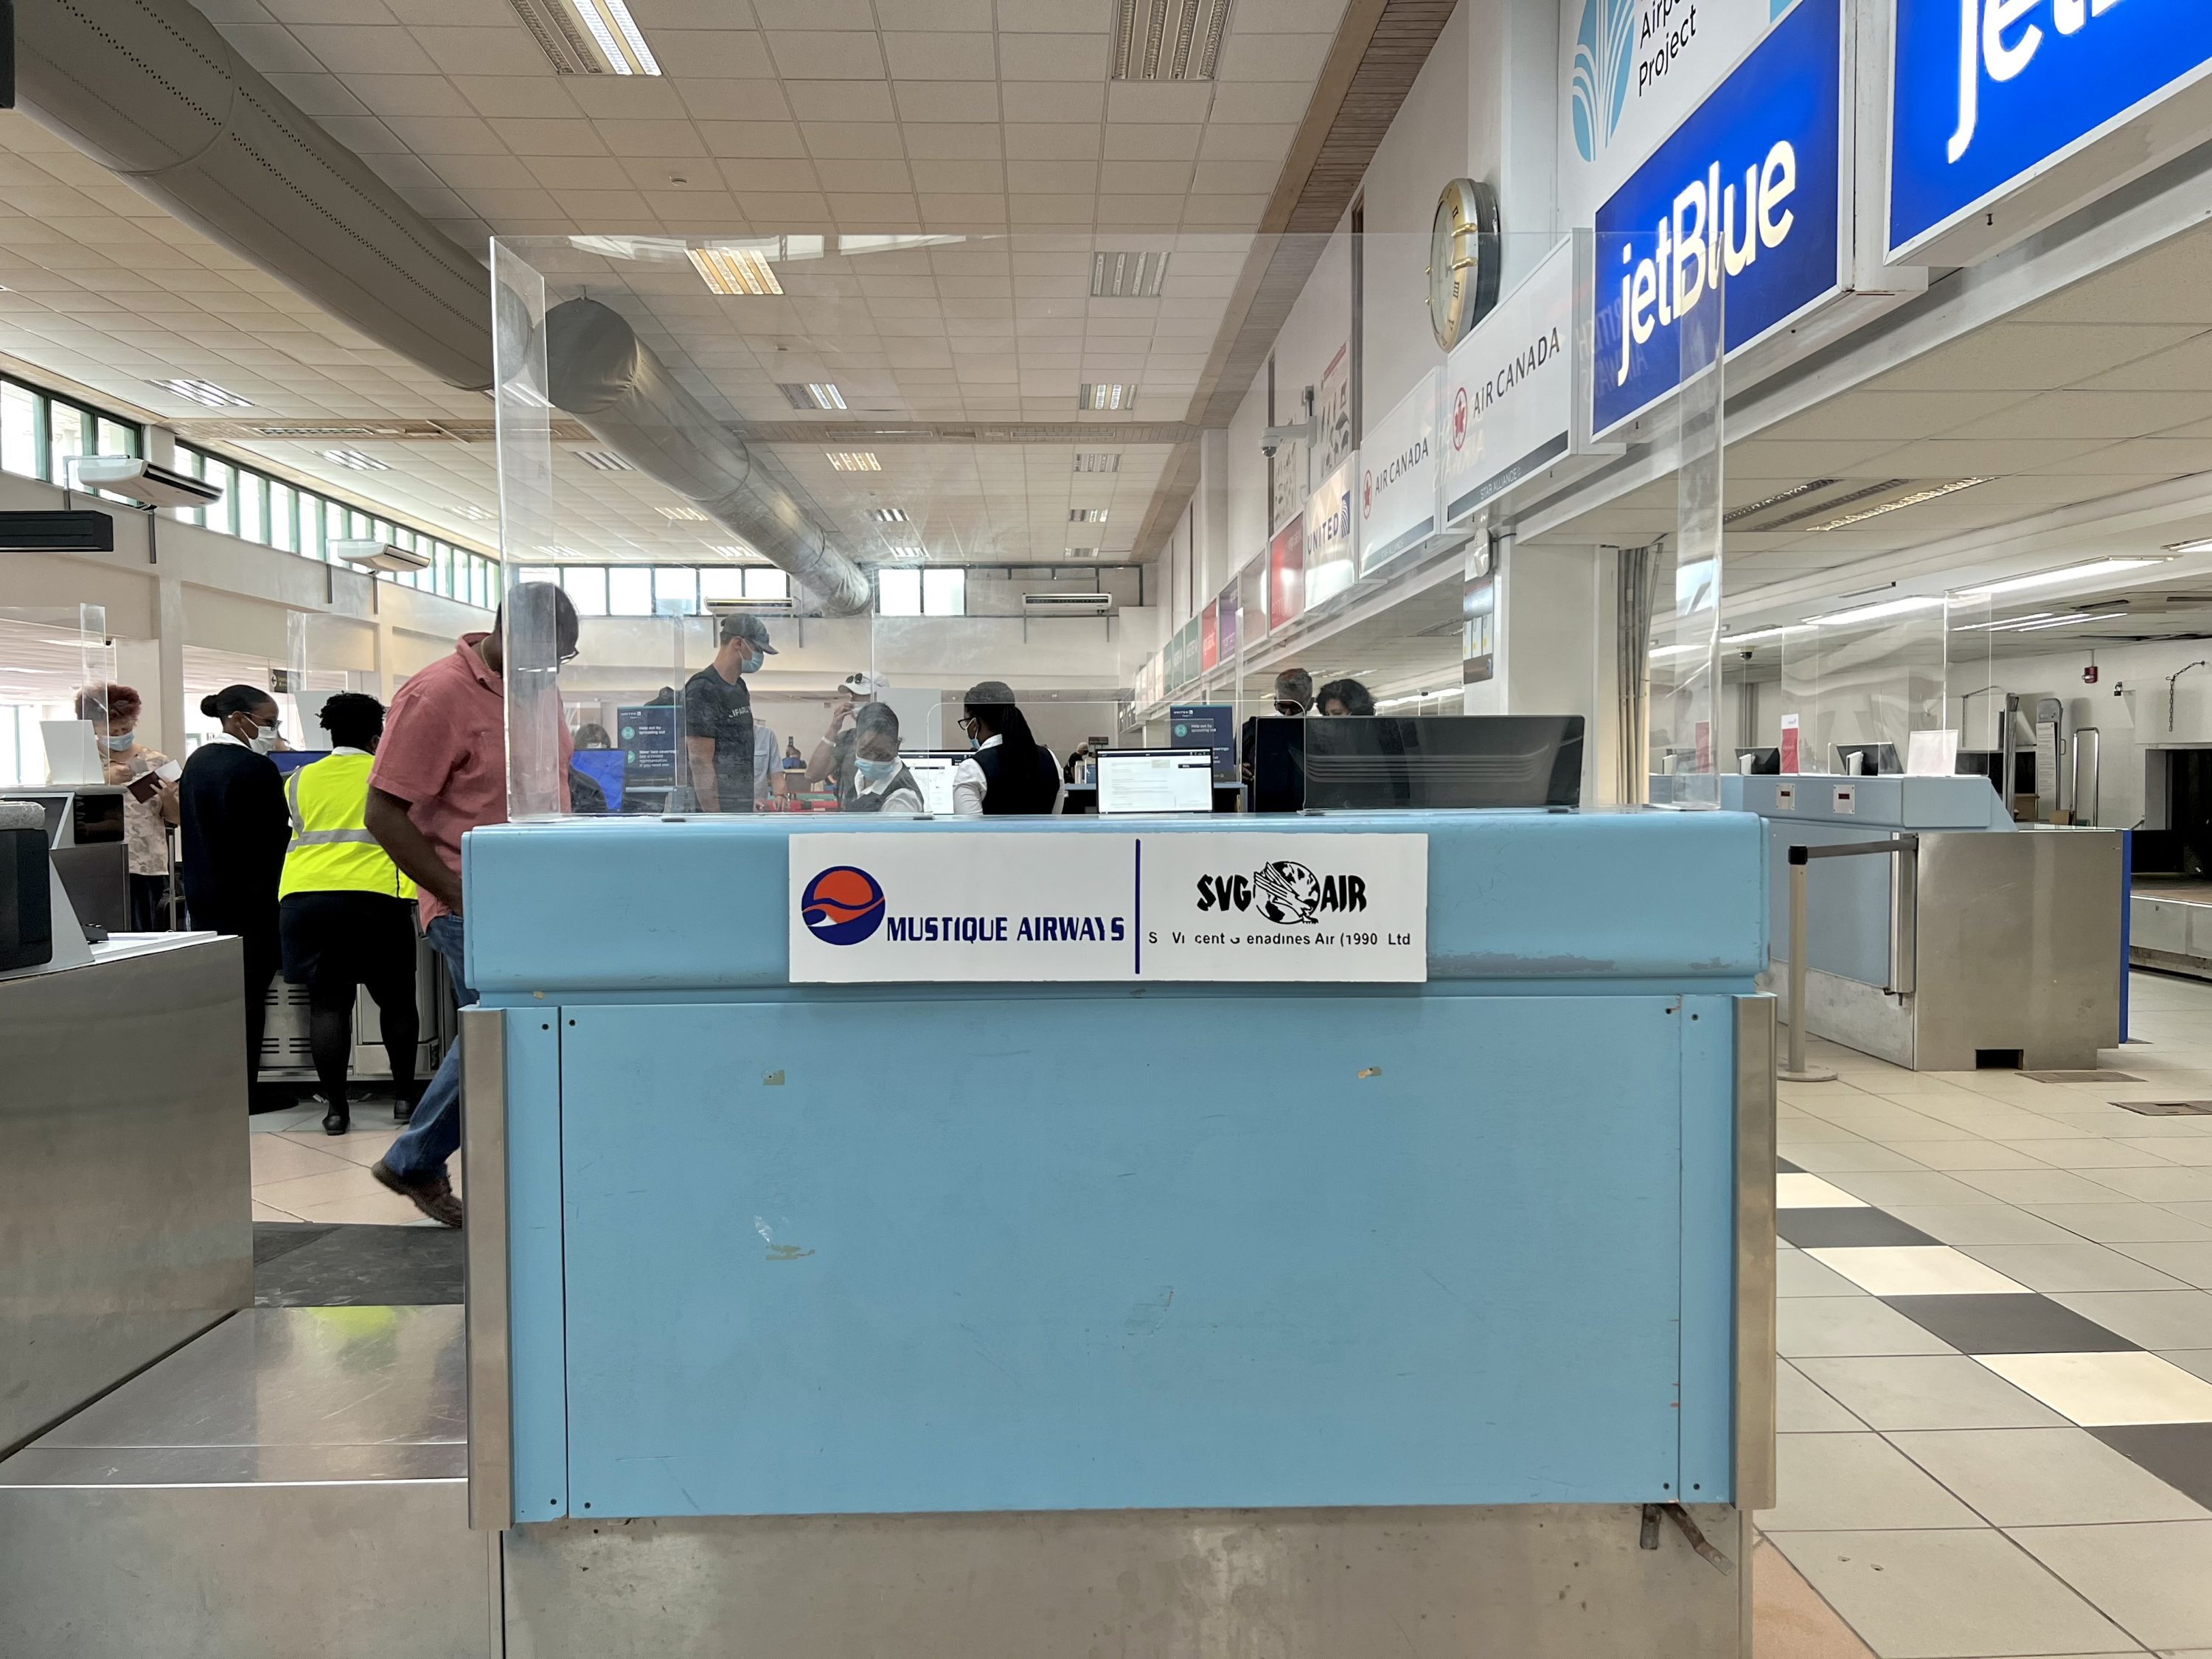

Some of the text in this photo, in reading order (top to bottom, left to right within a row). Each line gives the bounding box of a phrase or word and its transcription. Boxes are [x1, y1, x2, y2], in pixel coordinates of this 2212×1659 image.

[1640, 0, 1680, 49] Airp
[1639, 4, 1696, 97] Project
[1618, 140, 1796, 386] jetBlue
[1473, 327, 1559, 418] AIR CANADA
[1375, 469, 1388, 496] AIR
[1390, 437, 1429, 484] CANADA
[1480, 483, 1492, 500] STAR
[1307, 512, 1339, 555] UNITED
[1197, 874, 1367, 912] SVG AIR
[887, 917, 1124, 944] MUSTIQUE AIRWAYS
[1315, 932, 1335, 945] Air
[1388, 932, 1411, 945] Ltd
